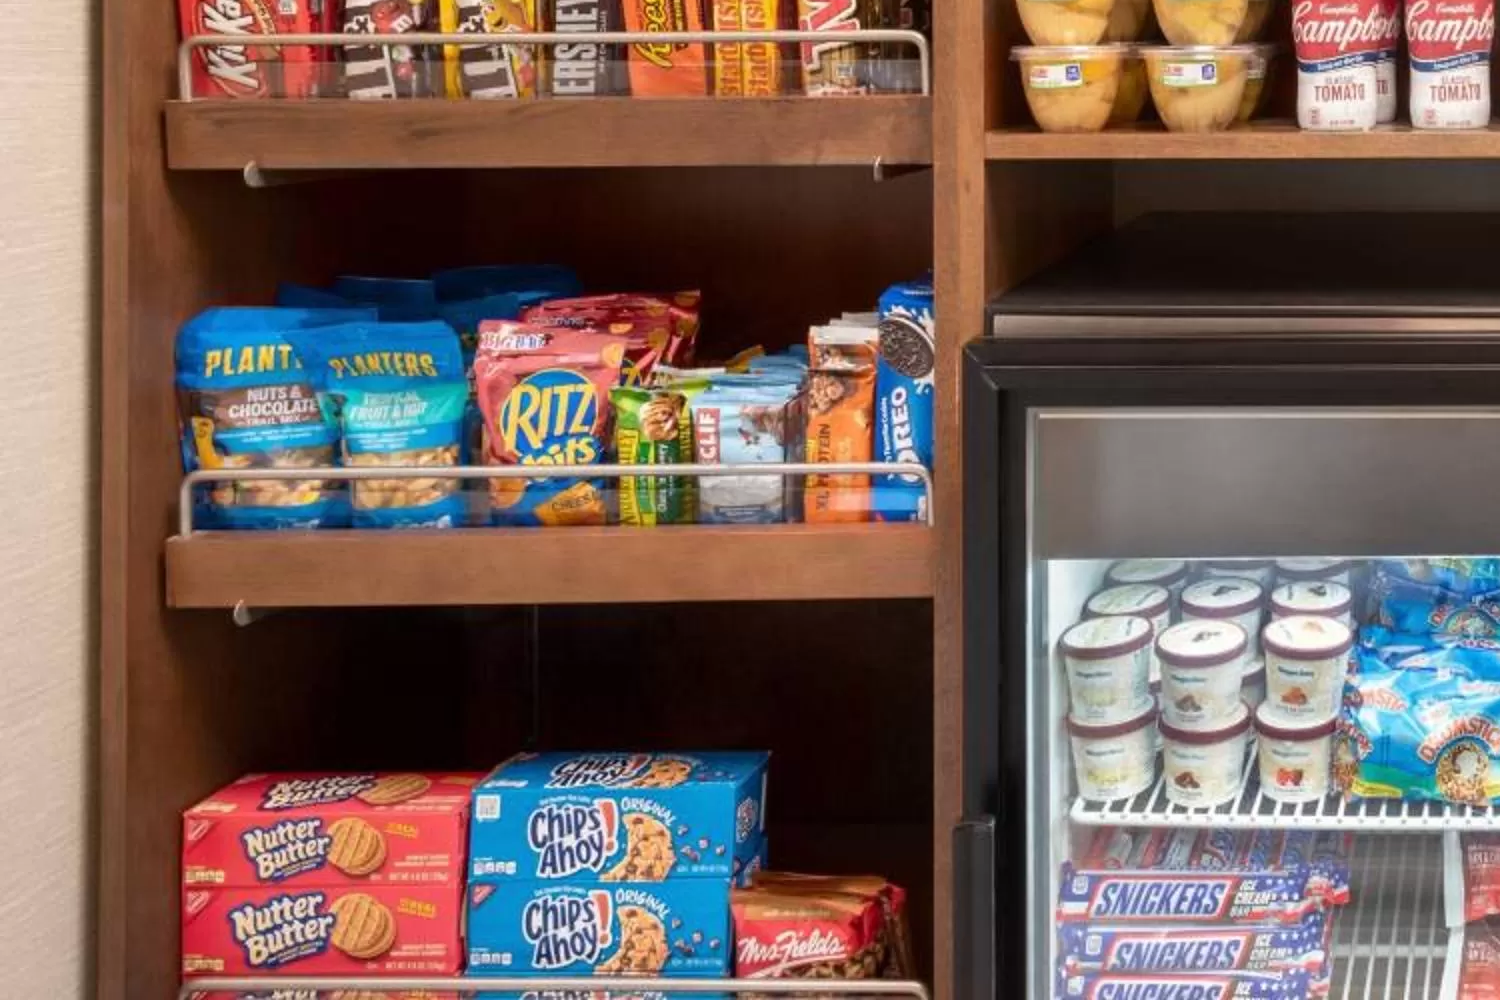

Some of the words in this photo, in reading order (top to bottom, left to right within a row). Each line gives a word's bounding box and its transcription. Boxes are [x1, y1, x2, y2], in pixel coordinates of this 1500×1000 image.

[1314, 83, 1365, 102] TOMATO
[1430, 84, 1481, 102] TOMATO
[204, 344, 303, 378] PLANT
[327, 352, 438, 378] PLANTERS
[247, 386, 287, 402] NUTS
[506, 383, 597, 453] RITZ
[890, 387, 920, 483] OREO
[699, 411, 716, 460] CLIF
[530, 804, 602, 849] Chips
[621, 796, 676, 827] ORIGINAL
[243, 818, 321, 853] Nutter
[256, 836, 331, 880] Butter
[1096, 880, 1228, 916] SNICKERS
[1239, 880, 1259, 890] ICE
[232, 893, 324, 941] Nutter
[525, 897, 596, 941] Chips
[615, 887, 671, 919] ORIGINAL
[246, 914, 335, 967] Butter
[1113, 938, 1243, 970] SNICKERS
[1256, 934, 1275, 946] ICE
